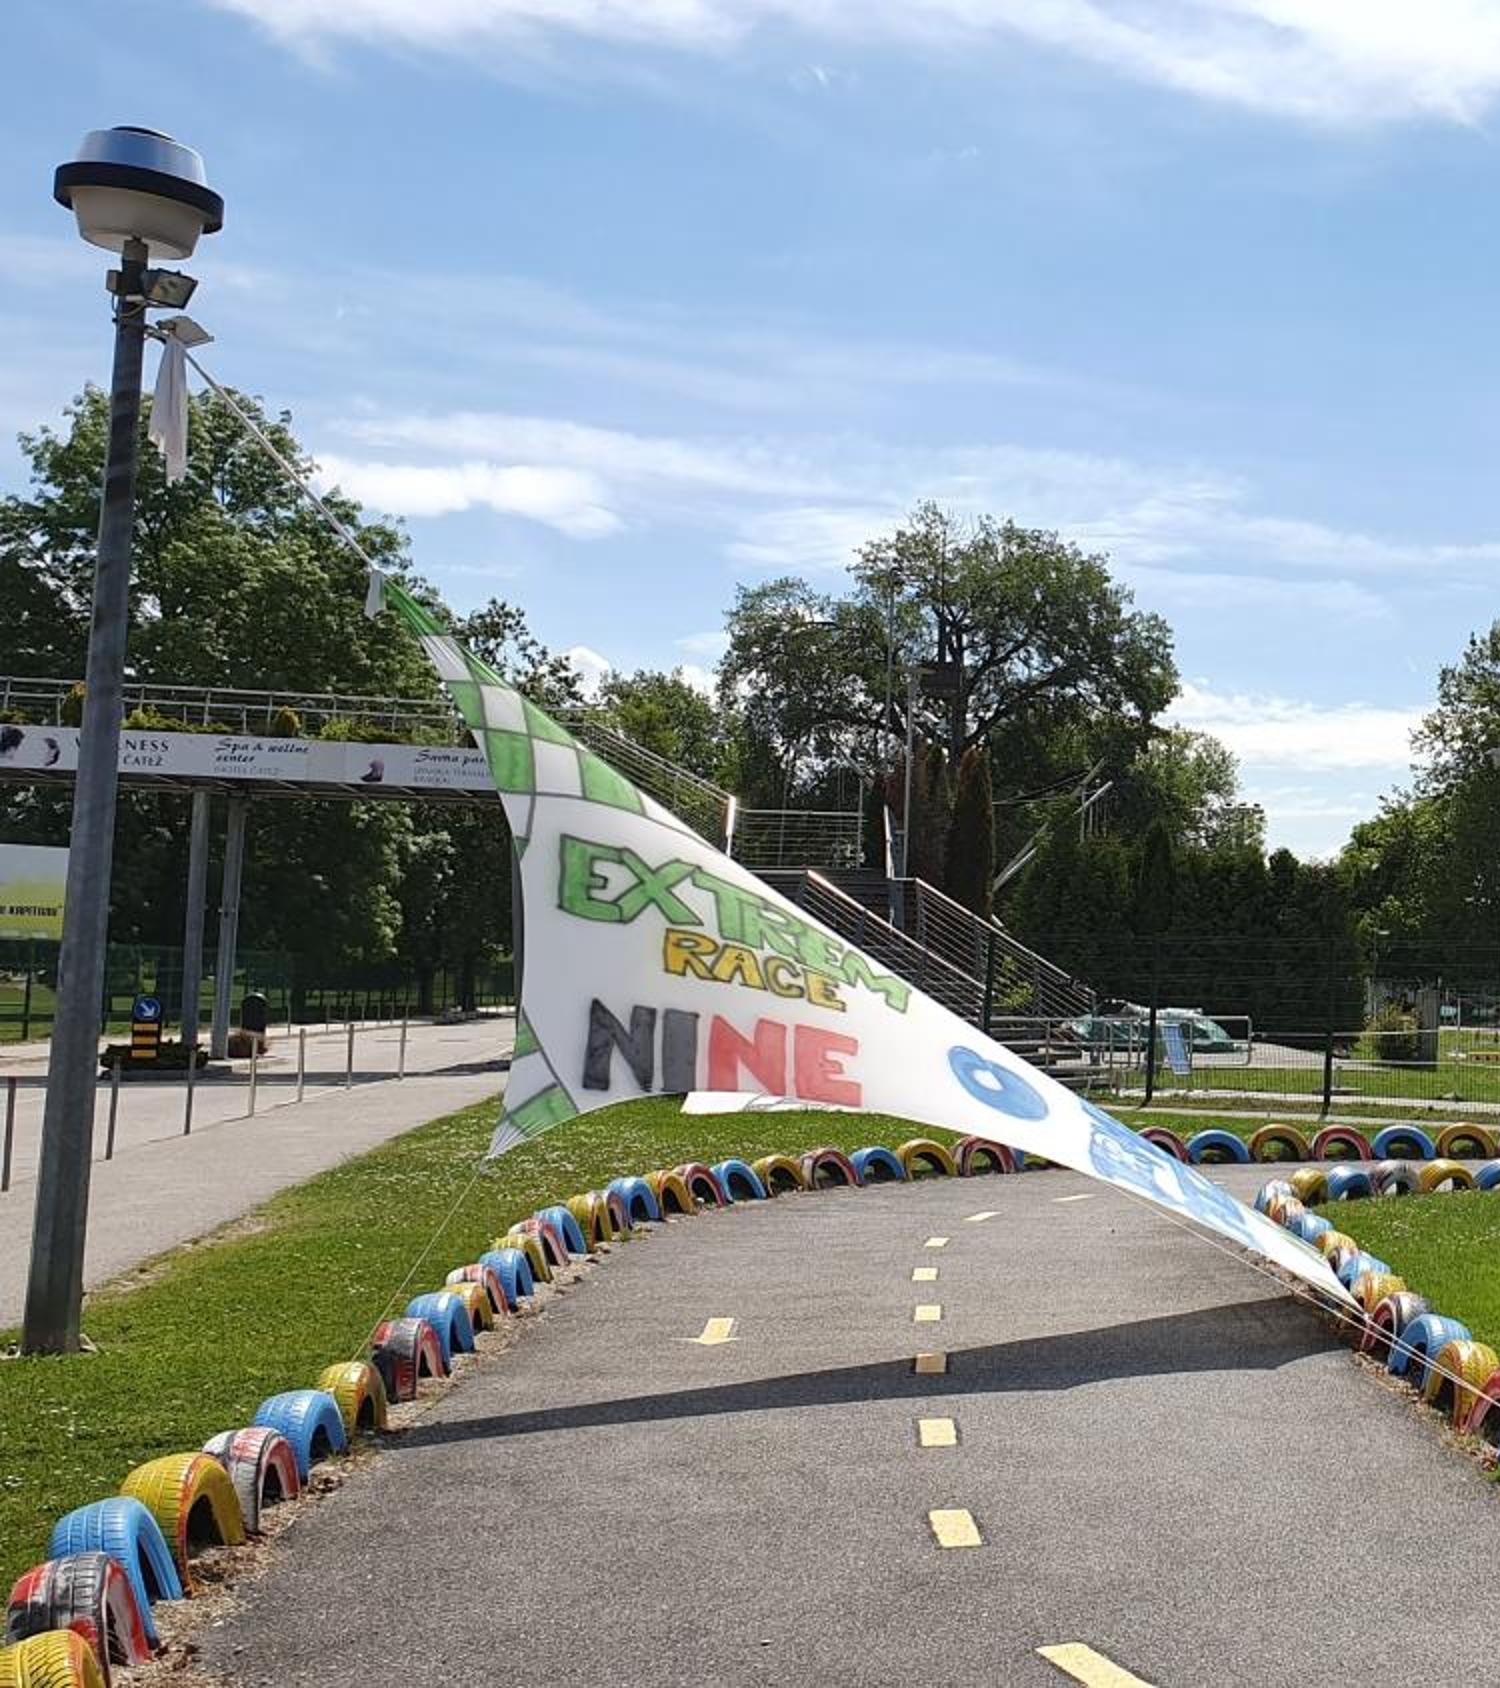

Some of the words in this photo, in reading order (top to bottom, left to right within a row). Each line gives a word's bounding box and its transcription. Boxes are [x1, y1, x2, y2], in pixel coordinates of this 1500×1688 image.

[214, 737, 249, 754] Spa
[557, 833, 912, 1014] EXTREM
[662, 927, 846, 1013] RACE
[581, 997, 863, 1108] NINE
